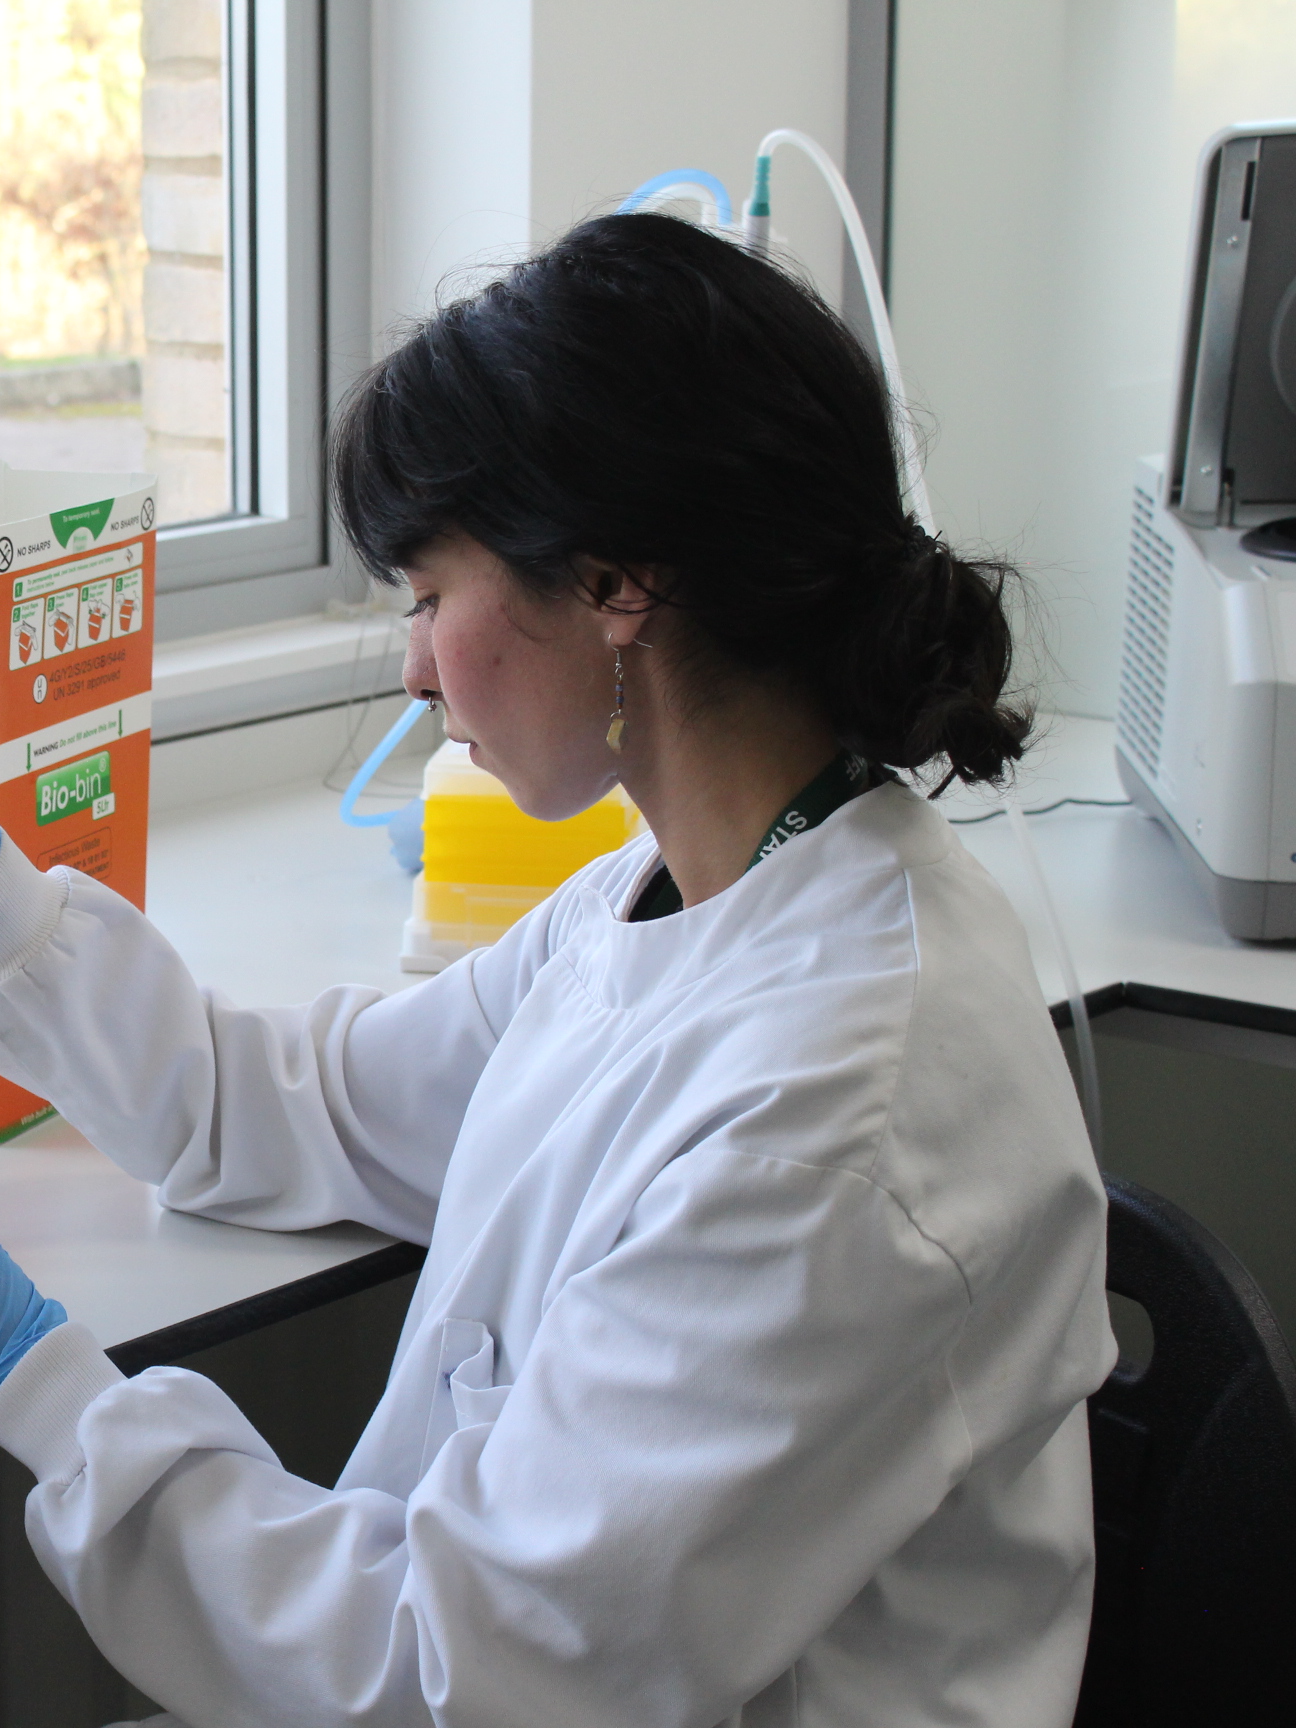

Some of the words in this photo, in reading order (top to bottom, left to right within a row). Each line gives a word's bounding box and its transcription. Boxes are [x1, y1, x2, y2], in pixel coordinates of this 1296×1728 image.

[110, 522, 121, 531] NO
[120, 515, 140, 529] SHARPS
[16, 546, 29, 557] NO
[28, 540, 51, 555] SHARPS
[53, 686, 65, 701] UN
[67, 679, 85, 696] 3291
[86, 669, 121, 690] approved
[33, 741, 59, 757] WARNING
